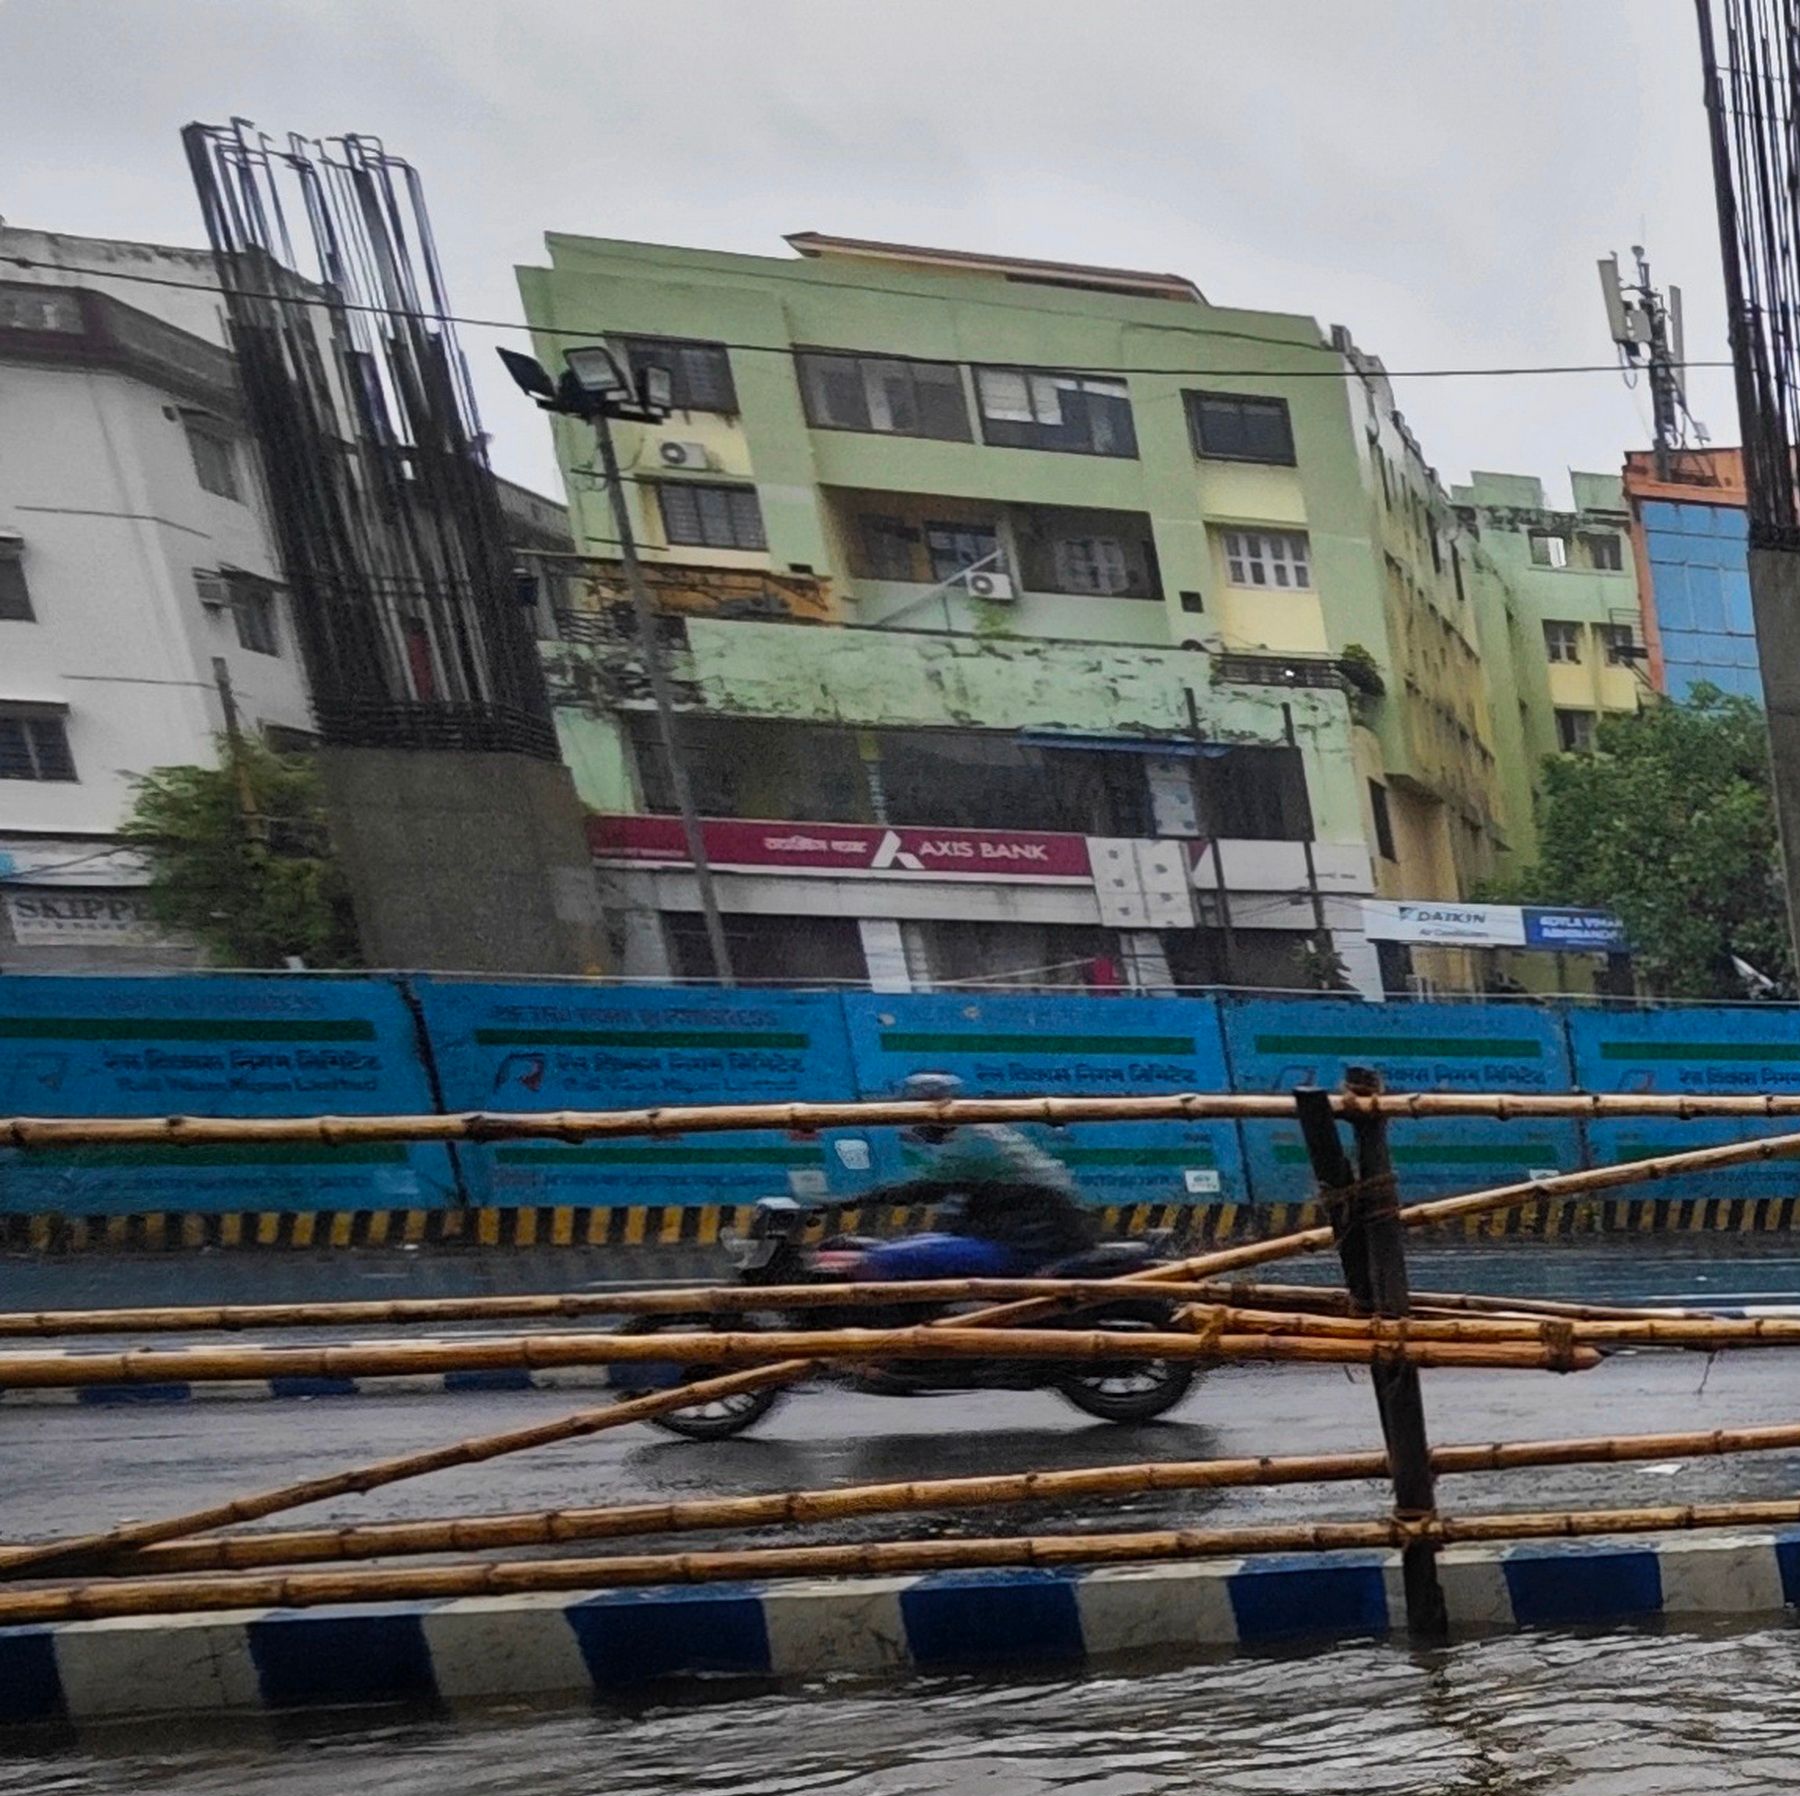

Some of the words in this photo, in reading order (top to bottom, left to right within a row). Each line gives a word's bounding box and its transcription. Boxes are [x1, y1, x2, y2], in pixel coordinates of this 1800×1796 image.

[919, 841, 973, 857] AXIS
[981, 843, 1047, 861] BANK
[1416, 910, 1486, 924] DAIKIN
